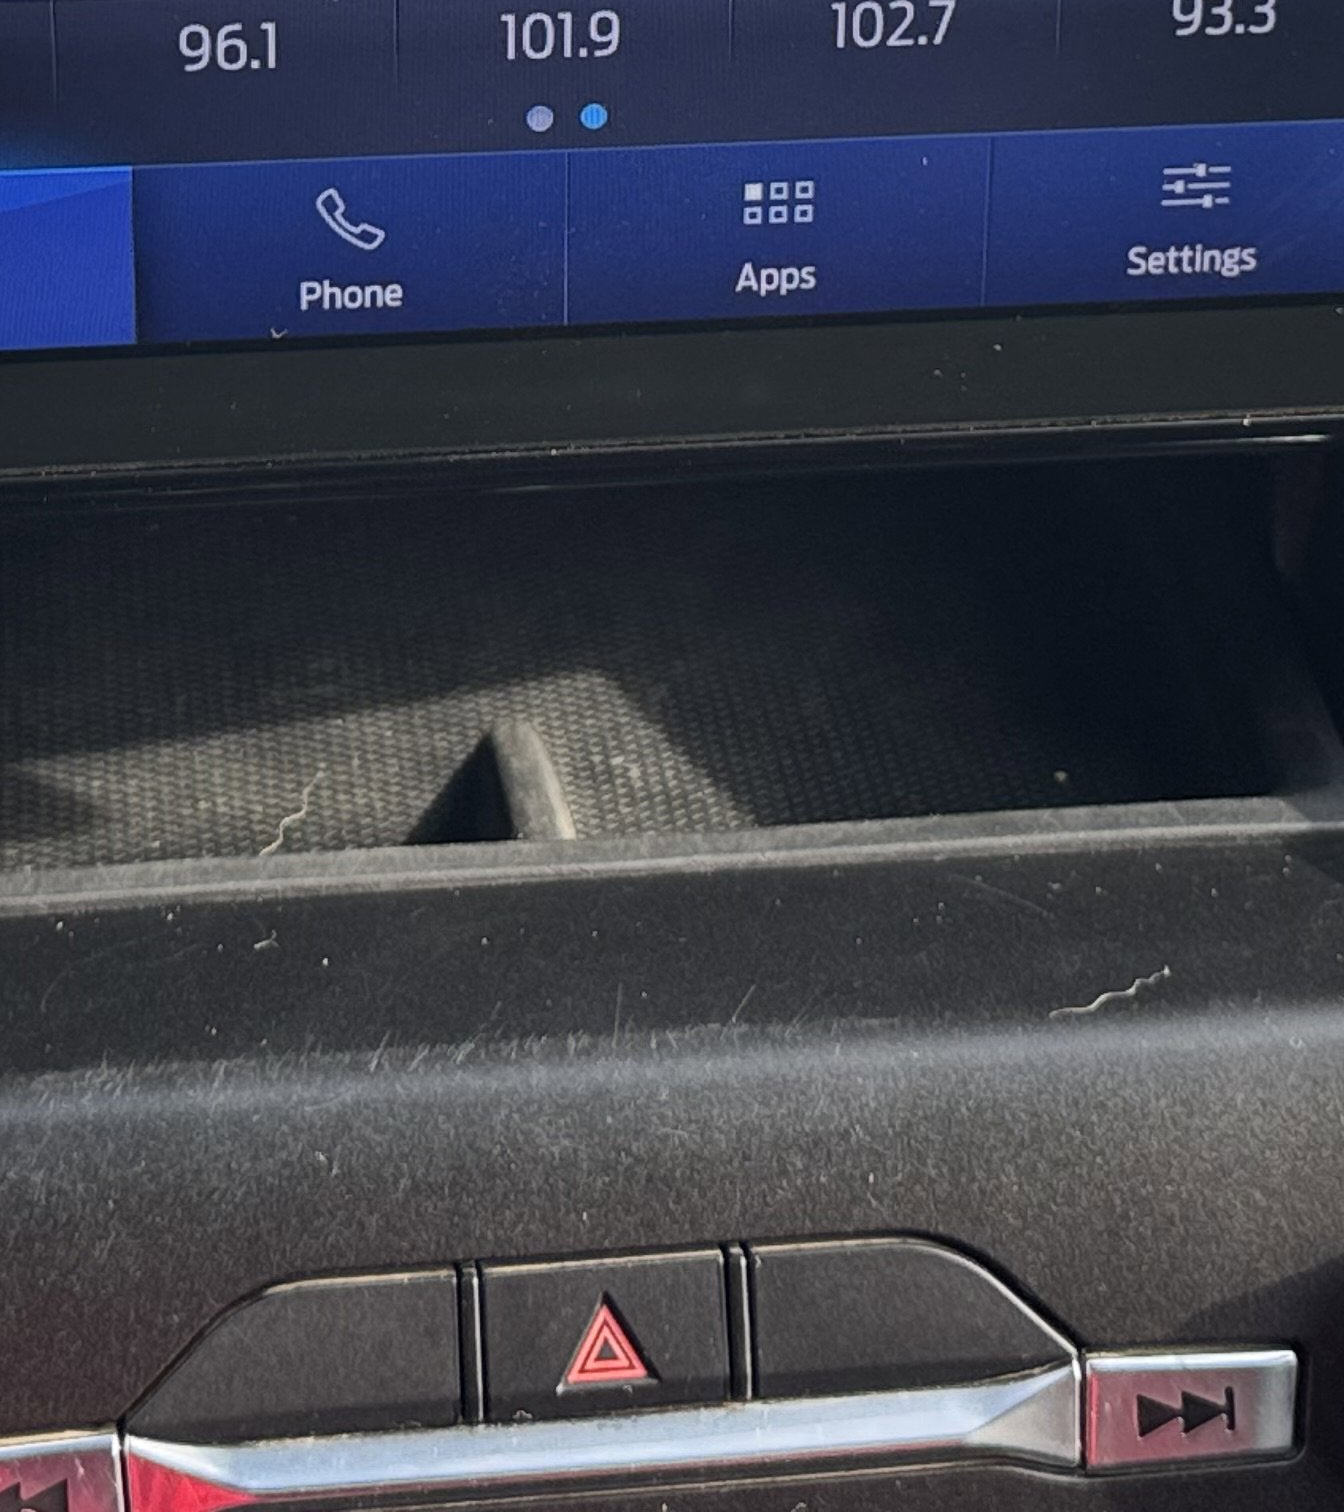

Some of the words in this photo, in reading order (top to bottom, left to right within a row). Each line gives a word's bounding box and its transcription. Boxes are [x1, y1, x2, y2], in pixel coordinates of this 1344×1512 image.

[179, 22, 276, 72] 96.1
[500, 10, 620, 60] 101.9
[1127, 243, 1257, 277] Settings
[300, 279, 403, 311] Phone
[735, 262, 816, 297] Apps
